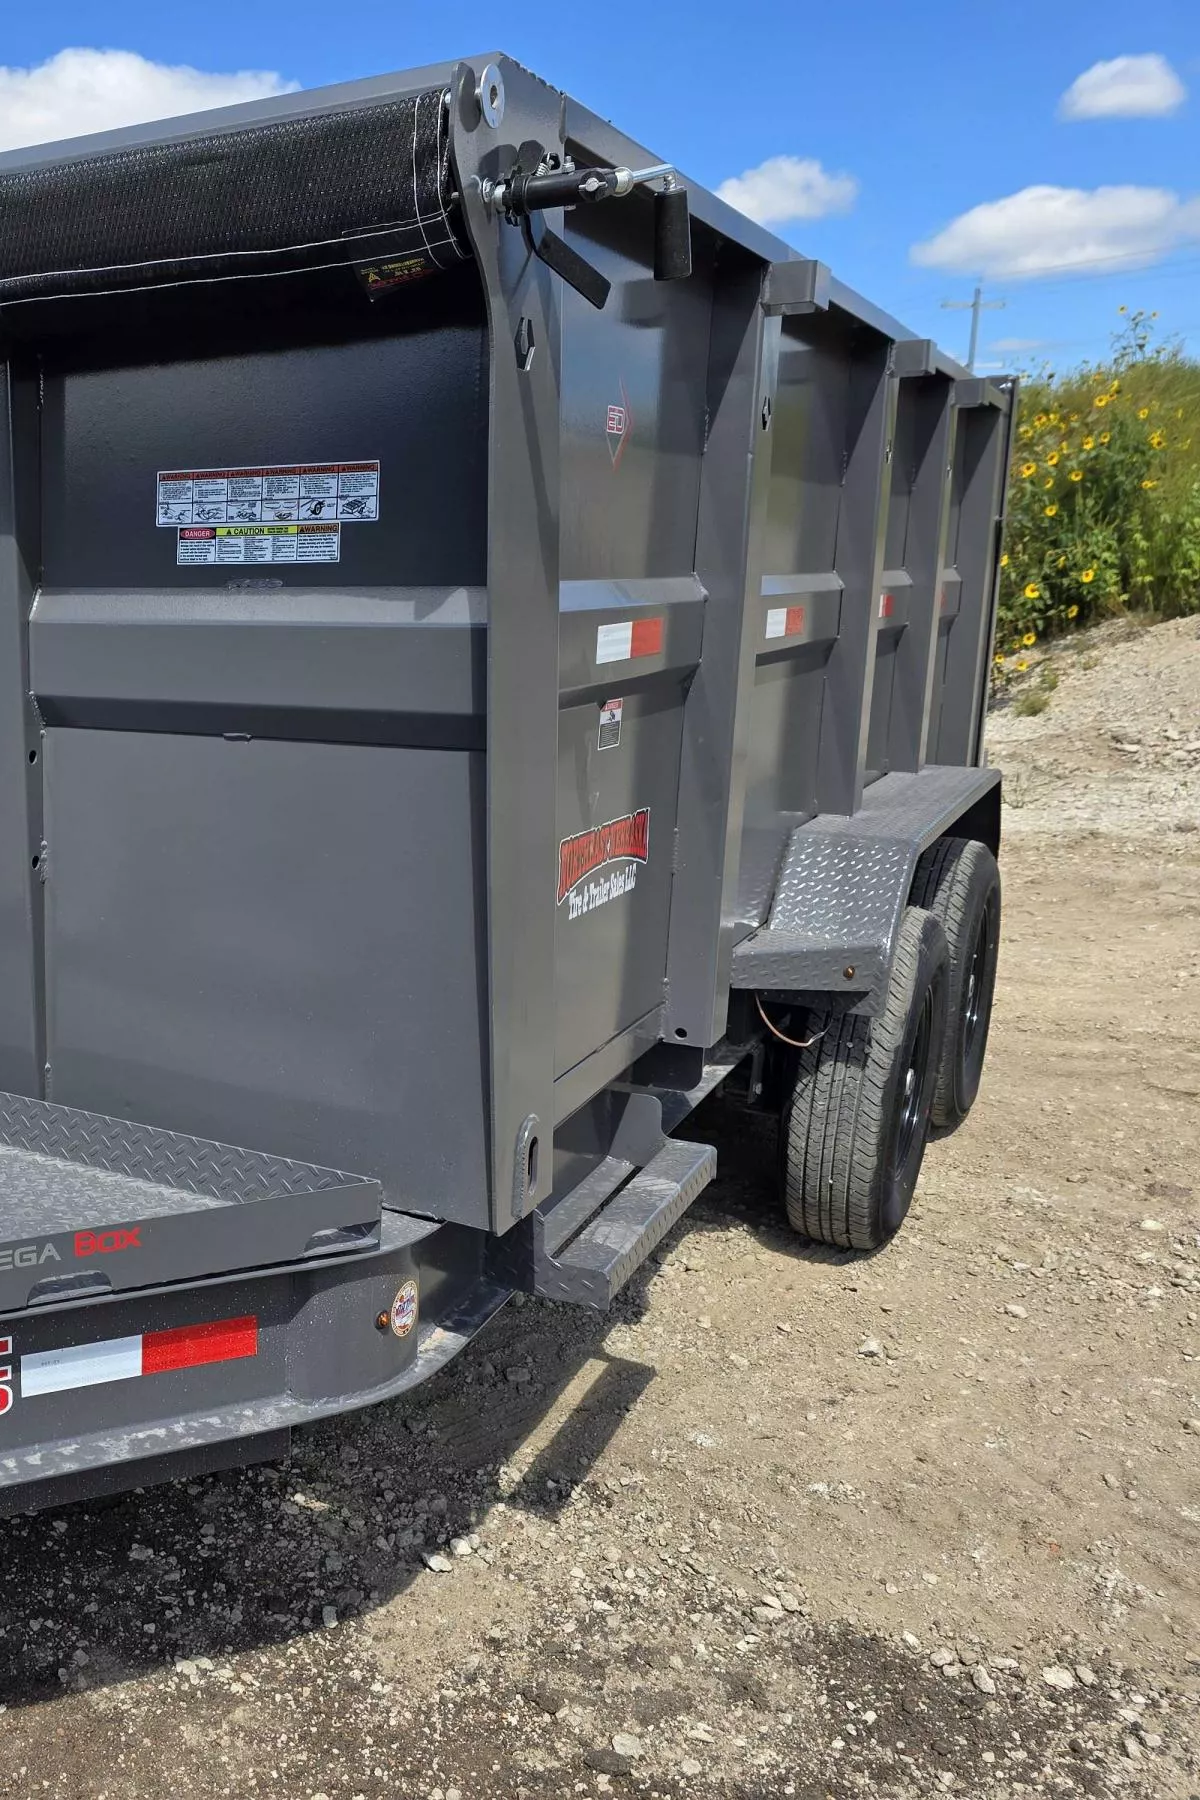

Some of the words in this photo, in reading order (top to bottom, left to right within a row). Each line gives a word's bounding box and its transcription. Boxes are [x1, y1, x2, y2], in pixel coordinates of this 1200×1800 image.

[234, 527, 265, 535] CAUTION
[305, 524, 338, 533] WARNING
[589, 878, 610, 910] Trailer
[609, 871, 625, 900] Sales
[625, 863, 637, 892] LLC
